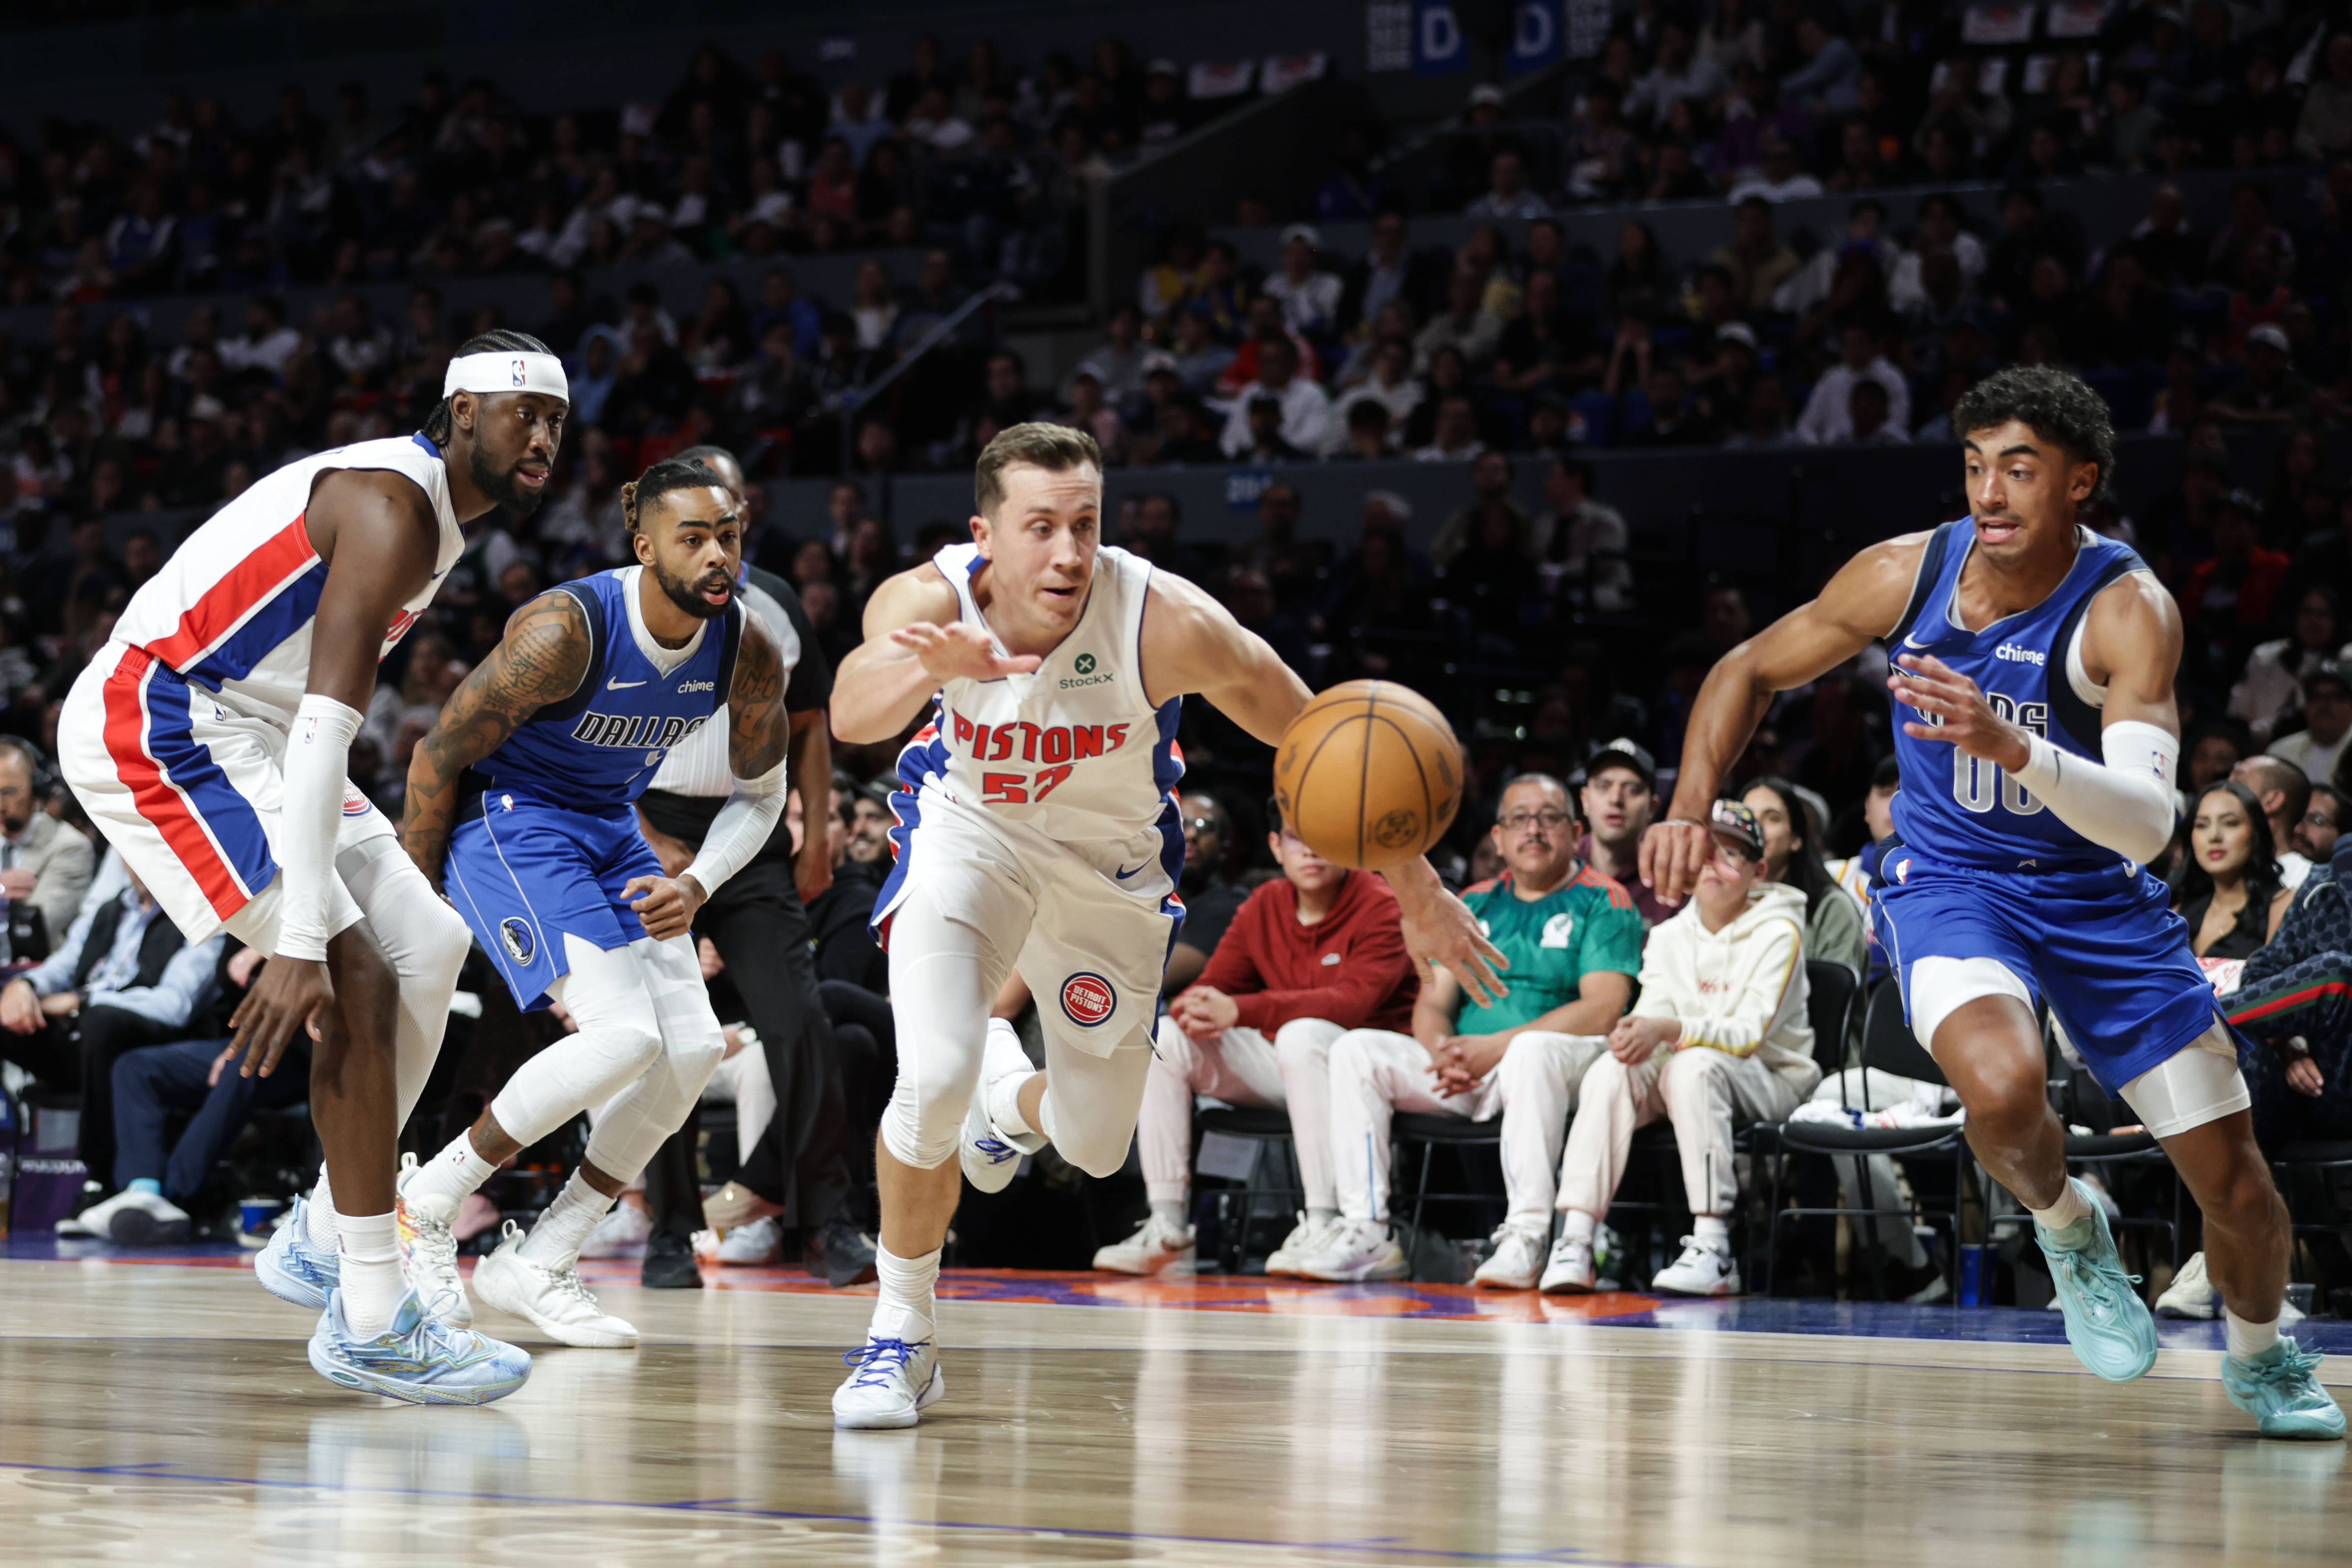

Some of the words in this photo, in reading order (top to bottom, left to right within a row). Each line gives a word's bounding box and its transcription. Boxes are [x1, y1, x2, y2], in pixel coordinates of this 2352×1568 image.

[1421, 6, 1461, 61] D
[1513, 3, 1554, 57] D
[1995, 642, 2045, 666] chime
[677, 679, 714, 694] chime
[1059, 672, 1114, 689] StockX
[952, 707, 1131, 763] PISTONS
[1070, 993, 1104, 1013] PISTONS
[1073, 985, 1107, 1004] DETROIT
